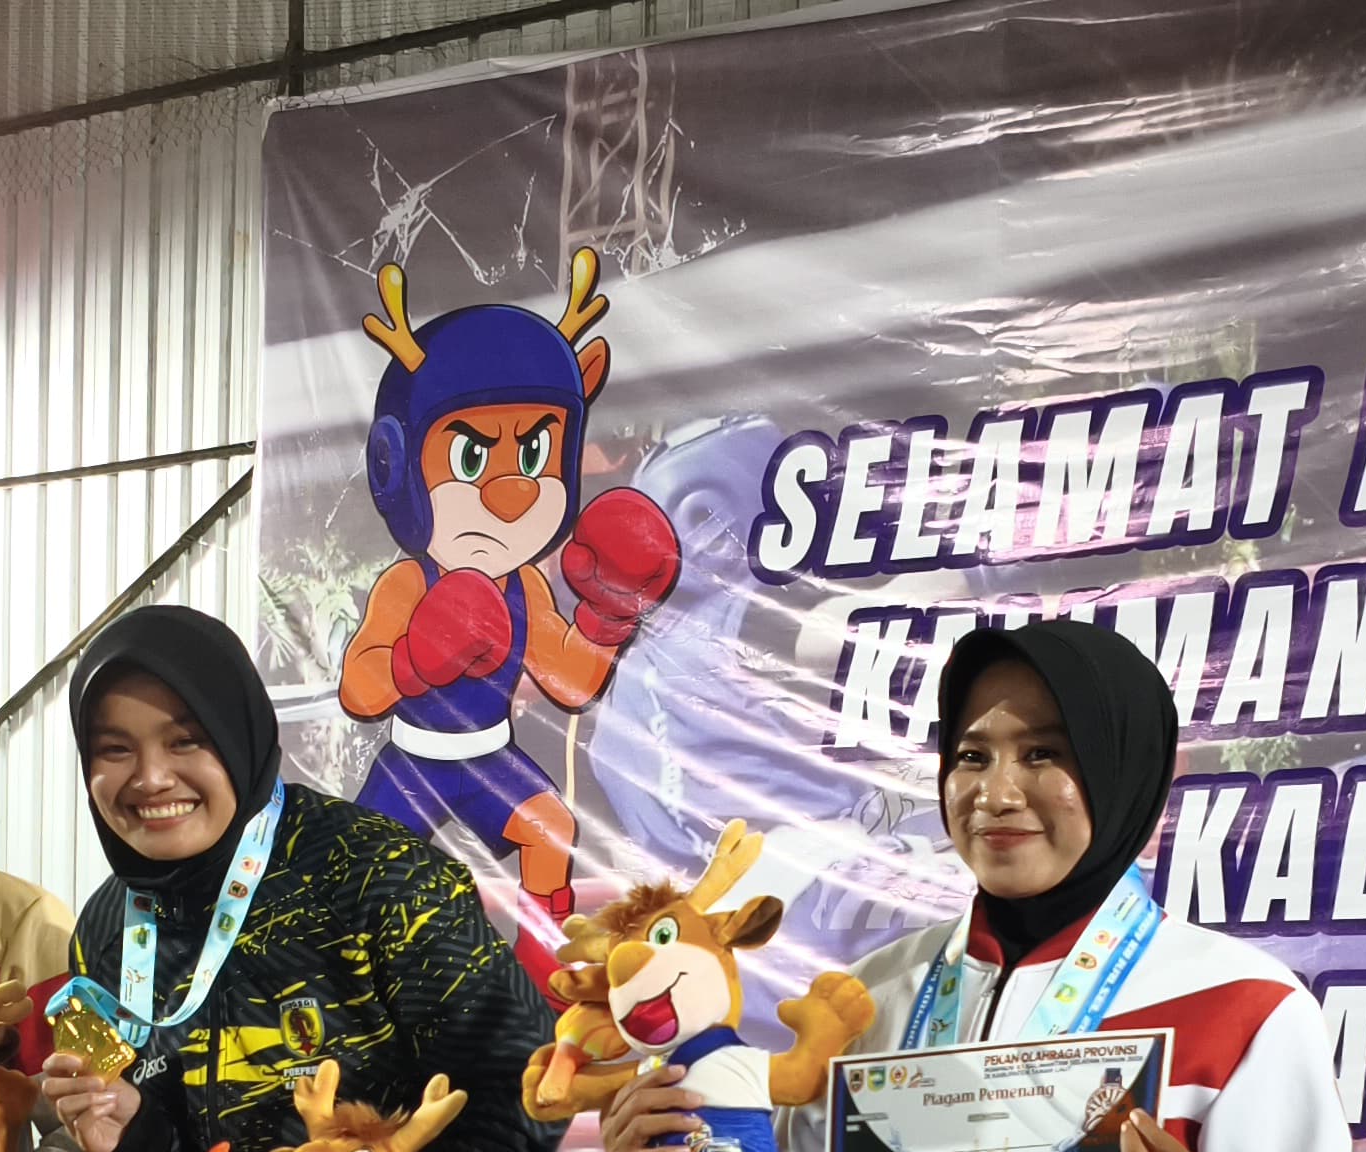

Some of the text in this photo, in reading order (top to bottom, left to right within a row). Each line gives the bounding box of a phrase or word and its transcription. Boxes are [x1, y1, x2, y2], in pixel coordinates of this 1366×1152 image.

[755, 378, 1315, 574] SELAMAT
[984, 1055, 1019, 1067] PEKAN
[1021, 1050, 1081, 1062] OLAHRAGA
[1084, 1045, 1138, 1059] PROVINSI
[923, 1083, 1055, 1107] Piagam Pemenang
